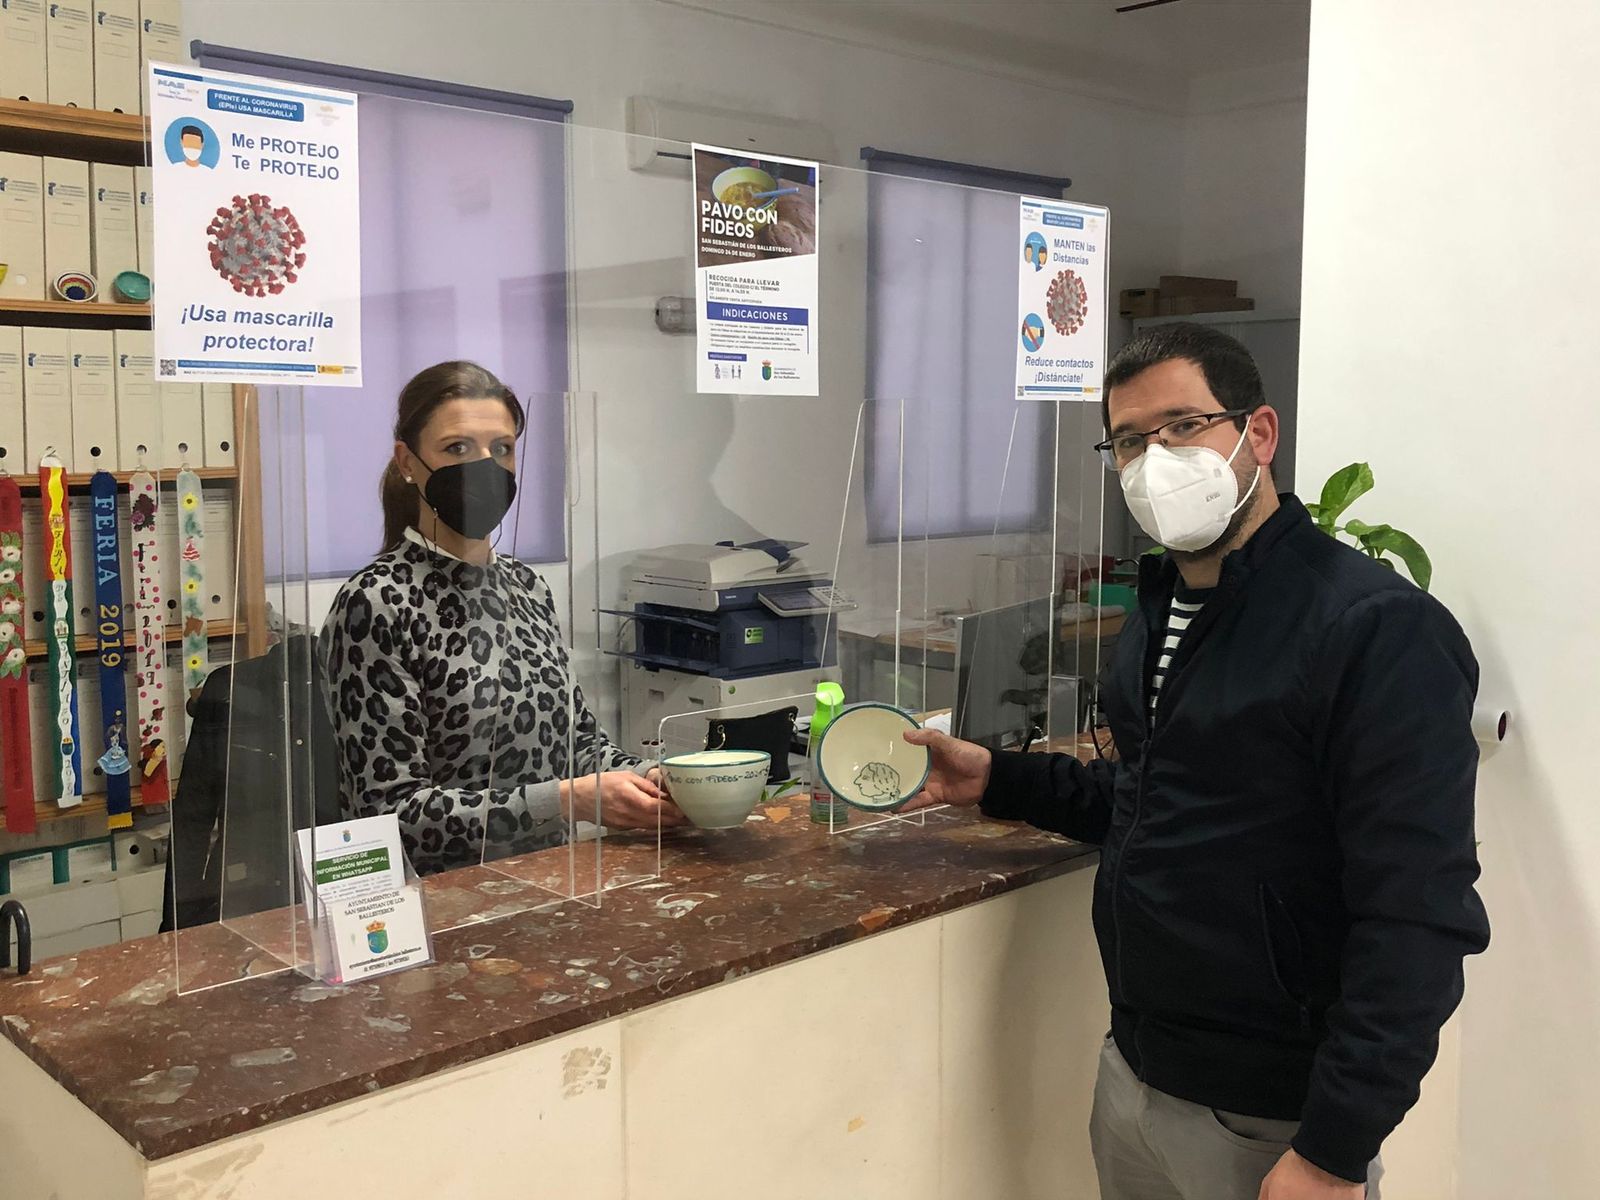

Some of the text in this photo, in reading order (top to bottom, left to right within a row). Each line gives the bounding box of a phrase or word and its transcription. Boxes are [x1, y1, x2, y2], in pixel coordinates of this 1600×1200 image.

[214, 92, 240, 103] FRENTE
[251, 98, 298, 111] CORONAVIRUS
[238, 104, 252, 112] USA
[252, 106, 294, 118] MASCARILLA
[232, 132, 339, 160] Me PROTEJO
[232, 154, 339, 180] Te PROTEJO
[701, 200, 778, 225] PAVO CON
[702, 217, 755, 239] FIDEOS
[757, 244, 792, 253] BALLESTEROS
[1054, 238, 1096, 252] MANTEN las
[1053, 252, 1089, 265] Distancias
[181, 304, 334, 329] ¡Usa mascarilla
[722, 308, 788, 321] INDICACIONES
[203, 334, 314, 352] protectora!
[1025, 355, 1094, 369] Reduce contactos
[94, 495, 120, 586] FERIA
[99, 604, 121, 667] 2019
[332, 853, 360, 864] SERVICIO
[356, 855, 387, 866] MUNICIPAL
[341, 866, 373, 878] WHATSAPP
[348, 893, 392, 908] AYUNTAMIENTO
[358, 907, 395, 920] BALLESTEROS
